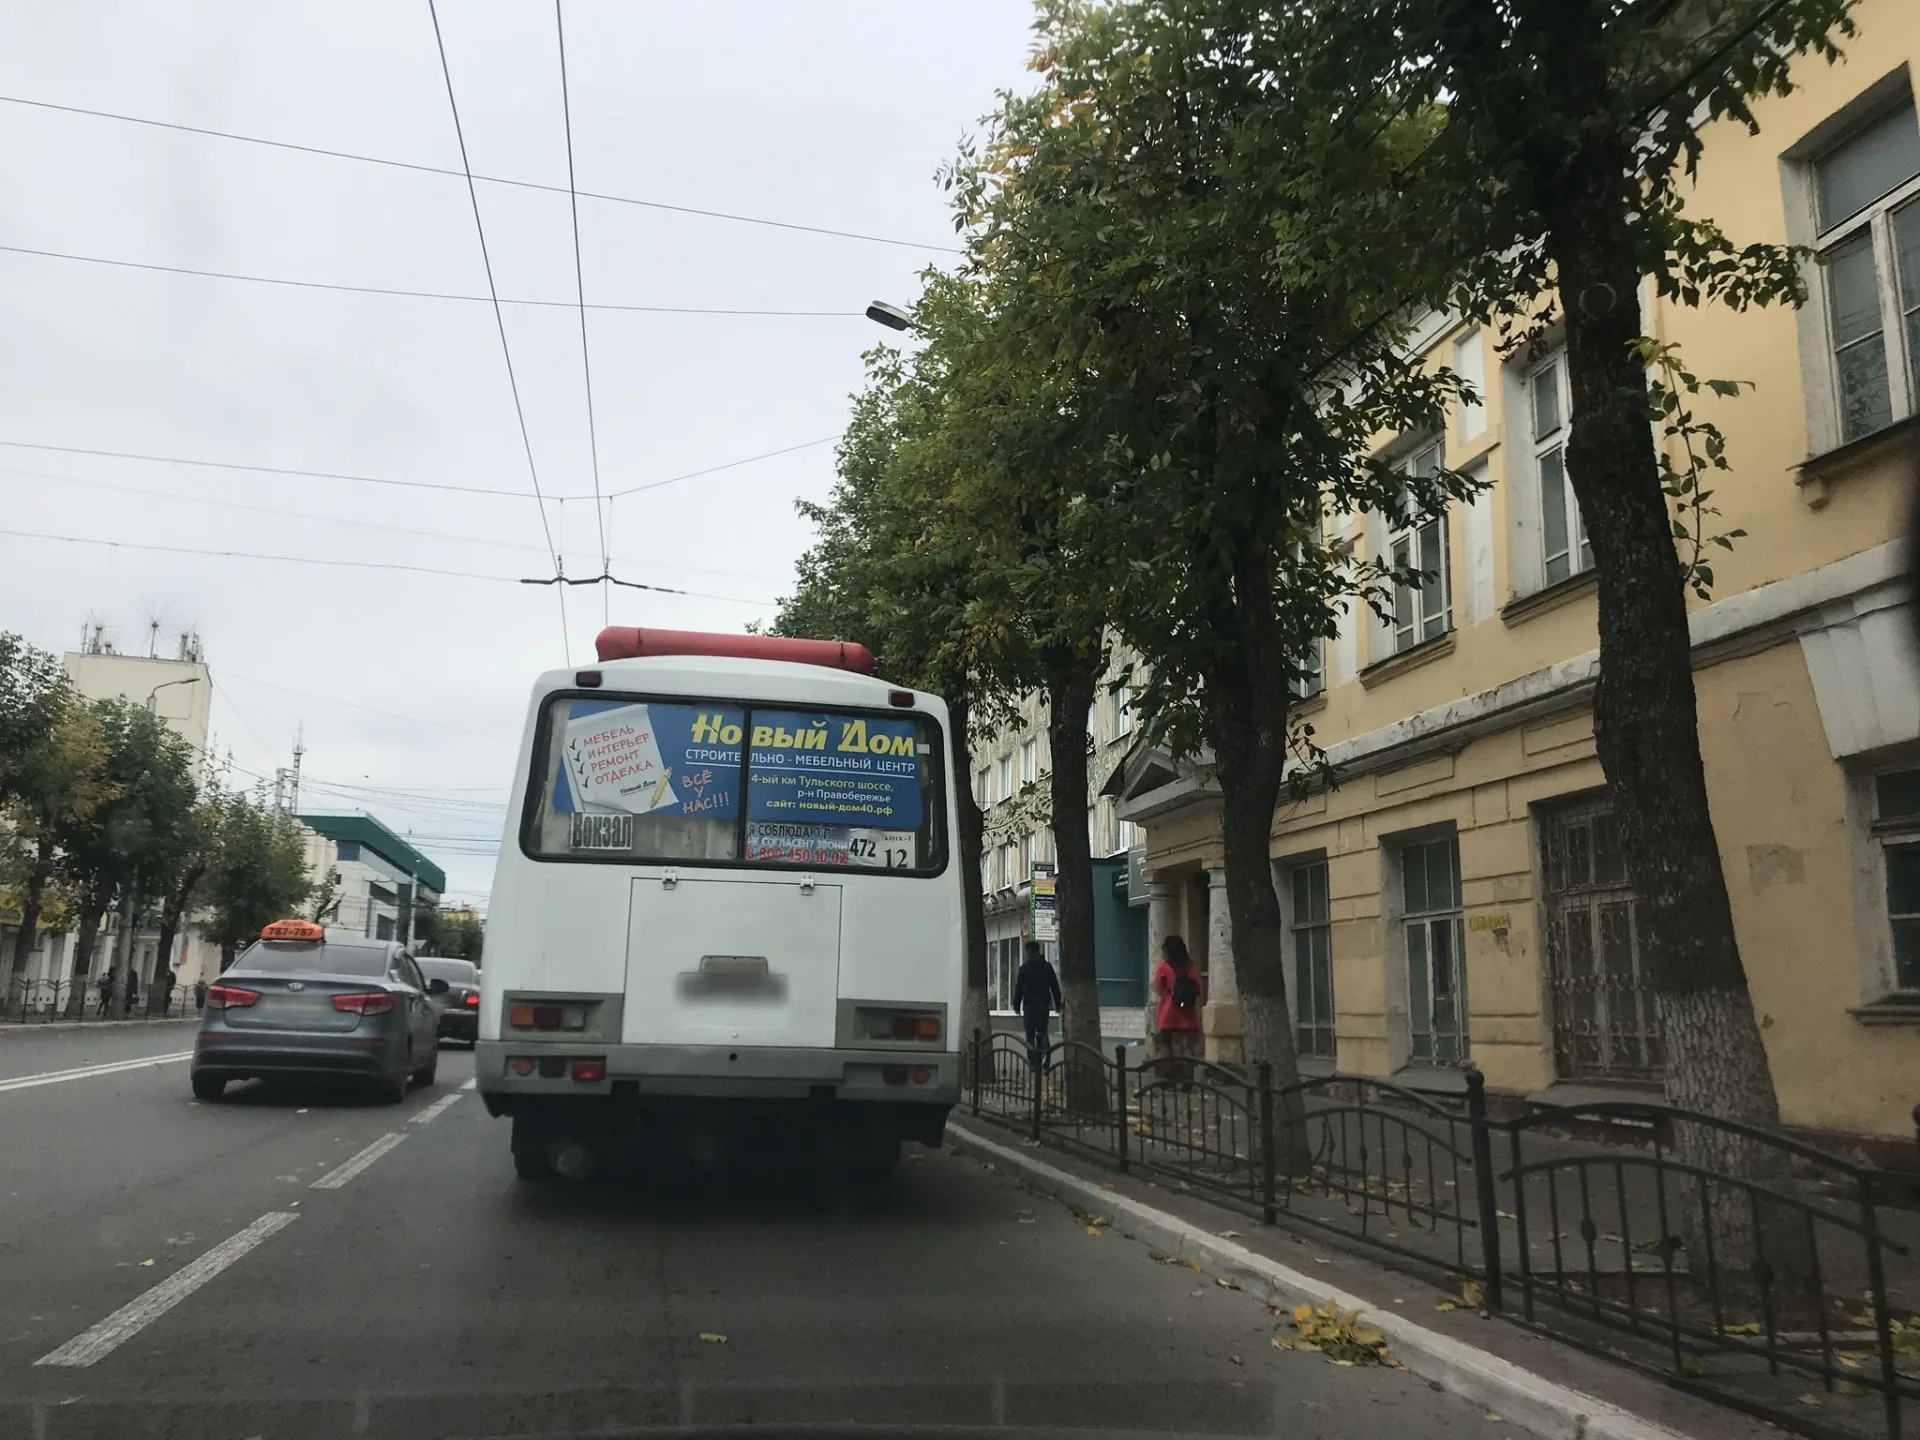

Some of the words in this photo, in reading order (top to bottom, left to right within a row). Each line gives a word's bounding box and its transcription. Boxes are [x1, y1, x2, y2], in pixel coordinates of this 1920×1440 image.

[583, 725, 635, 748] МЕБЕЛЬ
[588, 733, 650, 759] ИНТЕРЬЕР
[838, 720, 914, 757] Дом
[591, 749, 640, 772] РЕМОНТ
[795, 755, 871, 770] МЕБЕЛЬНЫЙ
[877, 761, 915, 773] ЦЕНТР
[595, 760, 654, 785] ОТДЕЛКА
[682, 769, 713, 788] ВСЁ
[751, 774, 779, 785] 4-ый
[781, 777, 796, 786] км
[799, 776, 855, 789] Тульского
[858, 782, 894, 793] шоссе,
[682, 792, 730, 814] НАС!!!
[797, 790, 814, 799] р-н
[817, 789, 891, 803] Правобережье
[766, 800, 796, 808] сайт:
[799, 801, 893, 816] новый-дом40.рф
[761, 837, 814, 849] СОГЛАСЕН?
[850, 838, 876, 858] 472
[787, 848, 811, 863] 450
[814, 850, 829, 864] 10
[884, 848, 908, 868] 12
[268, 927, 314, 937] 787-787
